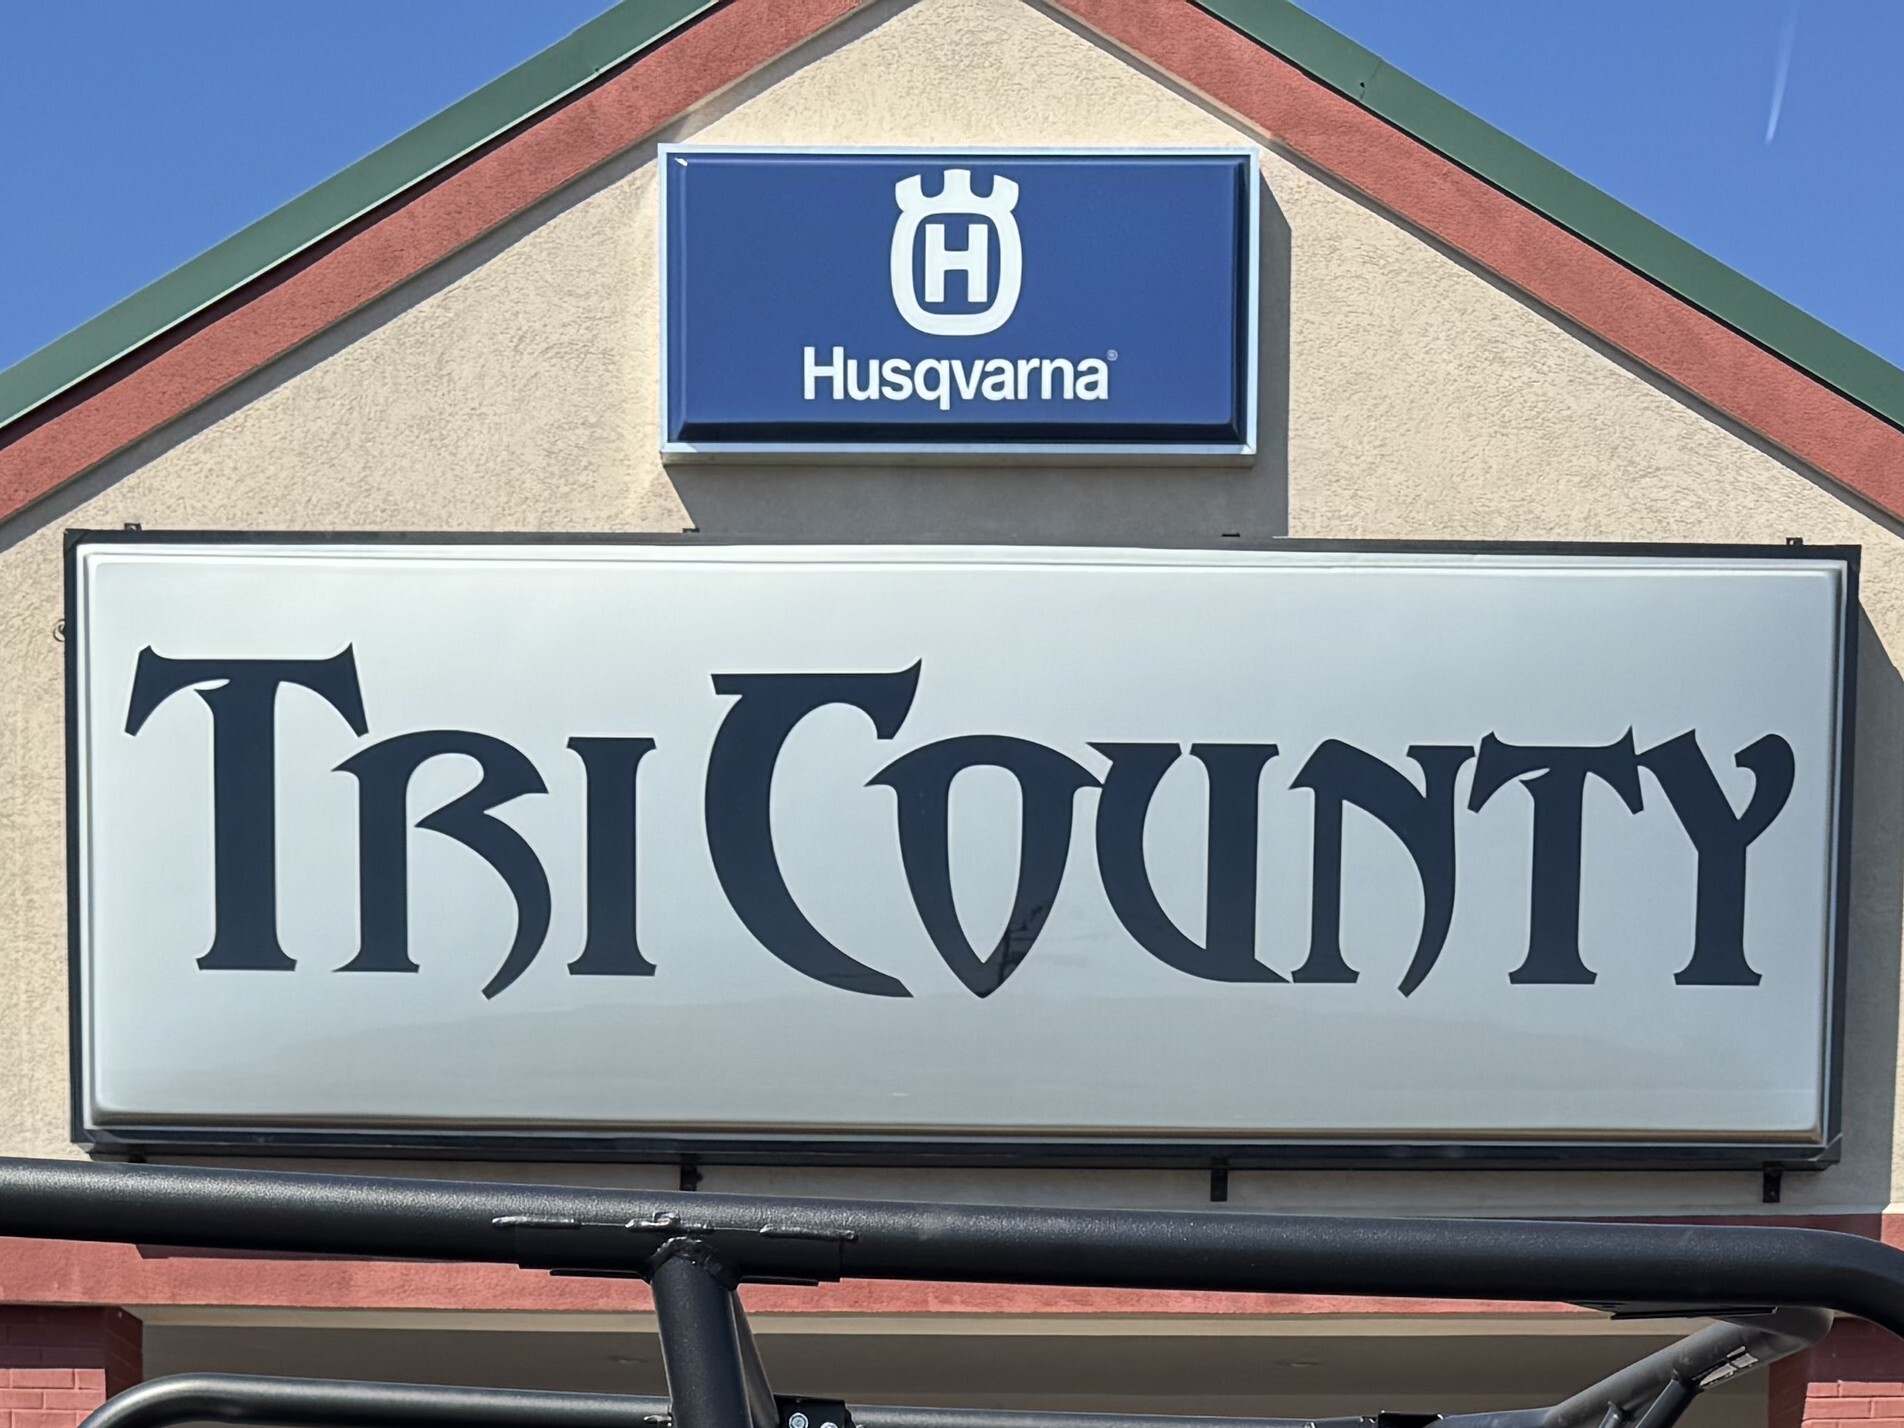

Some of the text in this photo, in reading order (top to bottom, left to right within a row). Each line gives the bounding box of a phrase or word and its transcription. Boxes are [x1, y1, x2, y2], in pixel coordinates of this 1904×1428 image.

[803, 346, 1110, 410] Husqvarna
[126, 643, 1797, 998] TRI COUNTY
